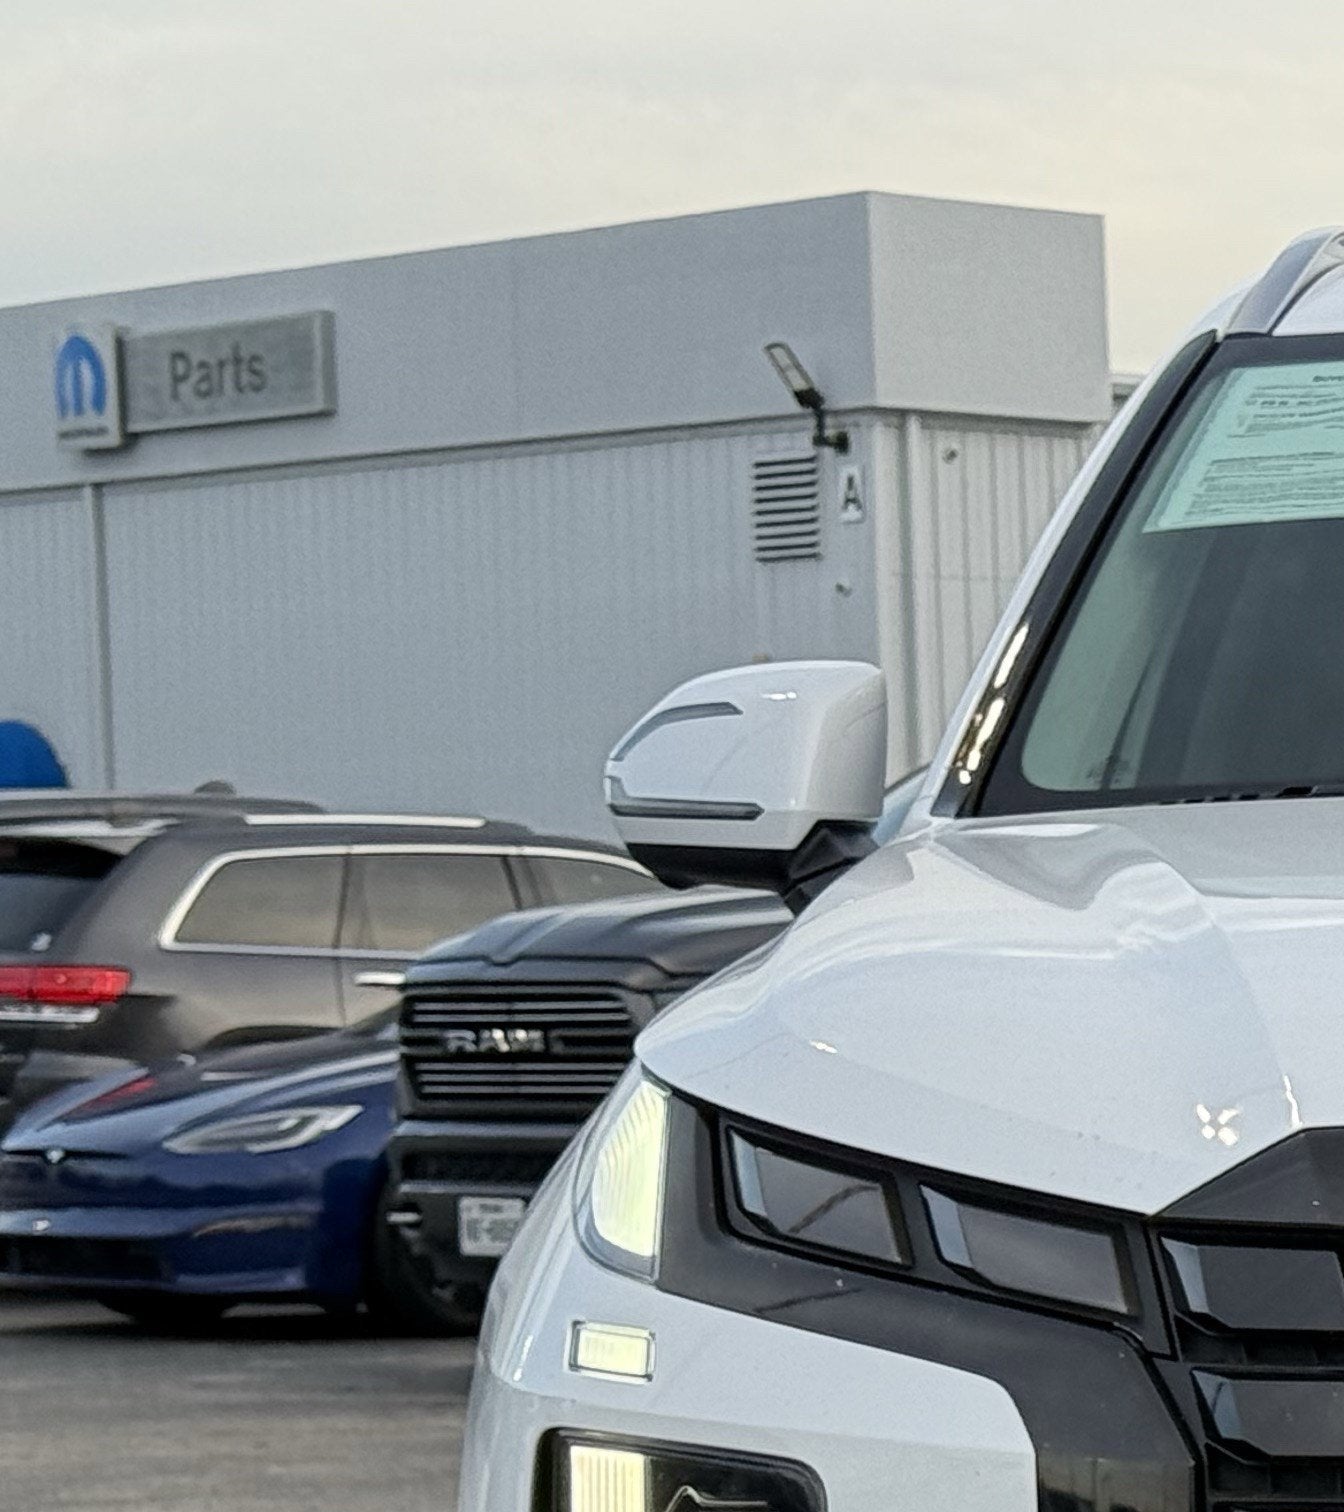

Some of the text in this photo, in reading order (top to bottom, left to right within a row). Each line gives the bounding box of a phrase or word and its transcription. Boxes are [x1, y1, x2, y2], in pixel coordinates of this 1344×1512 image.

[168, 342, 269, 402] Parts
[842, 474, 863, 511] A
[442, 1028, 545, 1053] RAM
